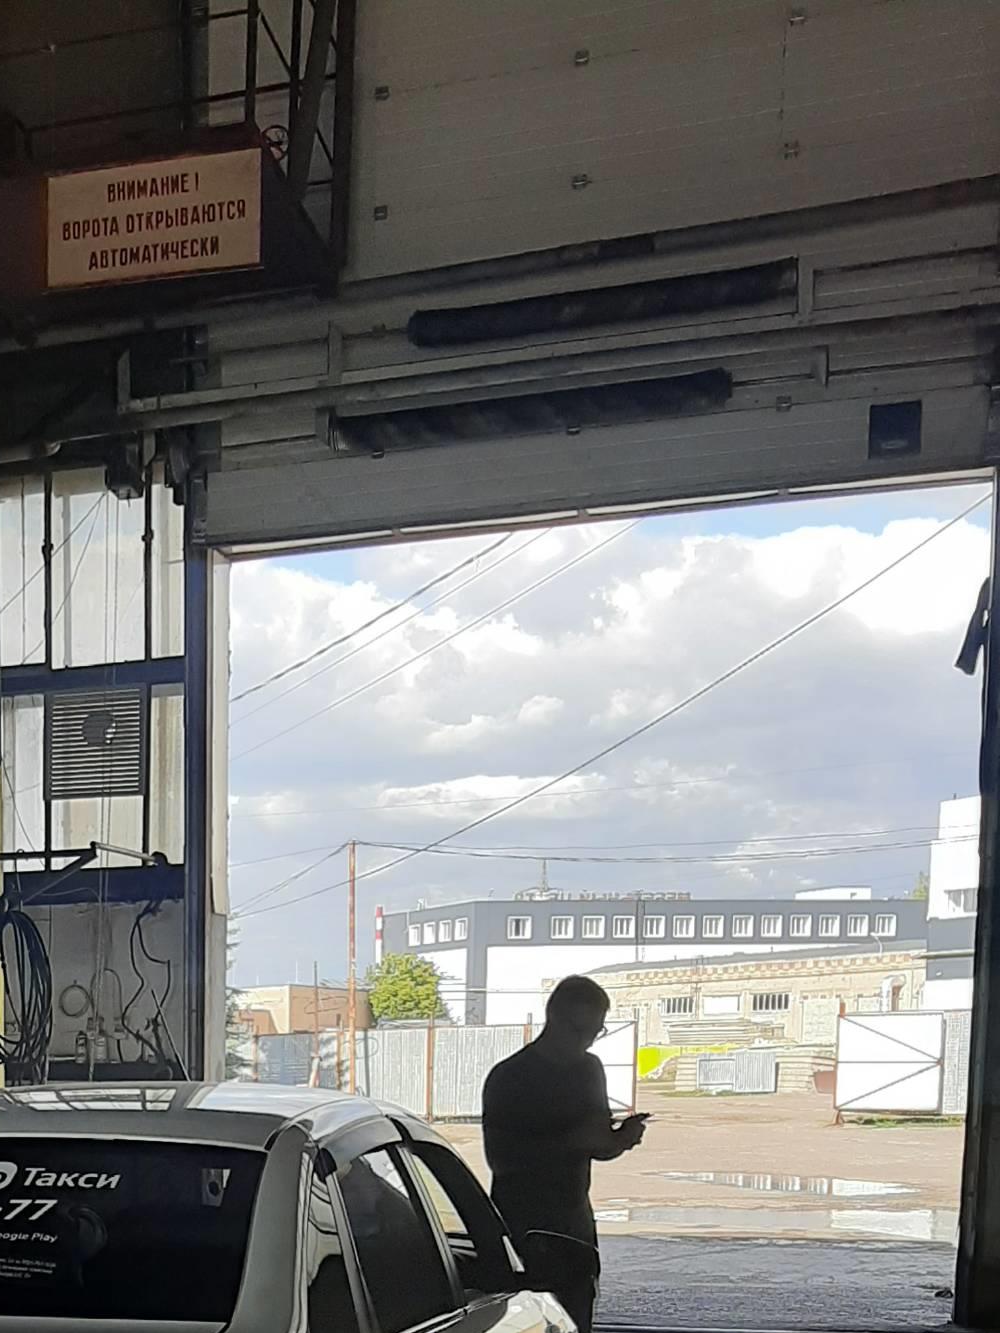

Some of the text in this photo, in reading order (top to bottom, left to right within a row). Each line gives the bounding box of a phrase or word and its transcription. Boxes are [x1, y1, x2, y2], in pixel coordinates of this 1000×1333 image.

[107, 173, 189, 203] ВНИМАНИЕ
[62, 199, 246, 242] ВОРОТА ОТКРЫВАЮТСЯ
[88, 235, 220, 271] АВТОМАТИЧЕСКИ
[23, 1167, 121, 1189] Такси
[30, 1233, 58, 1243] Play
